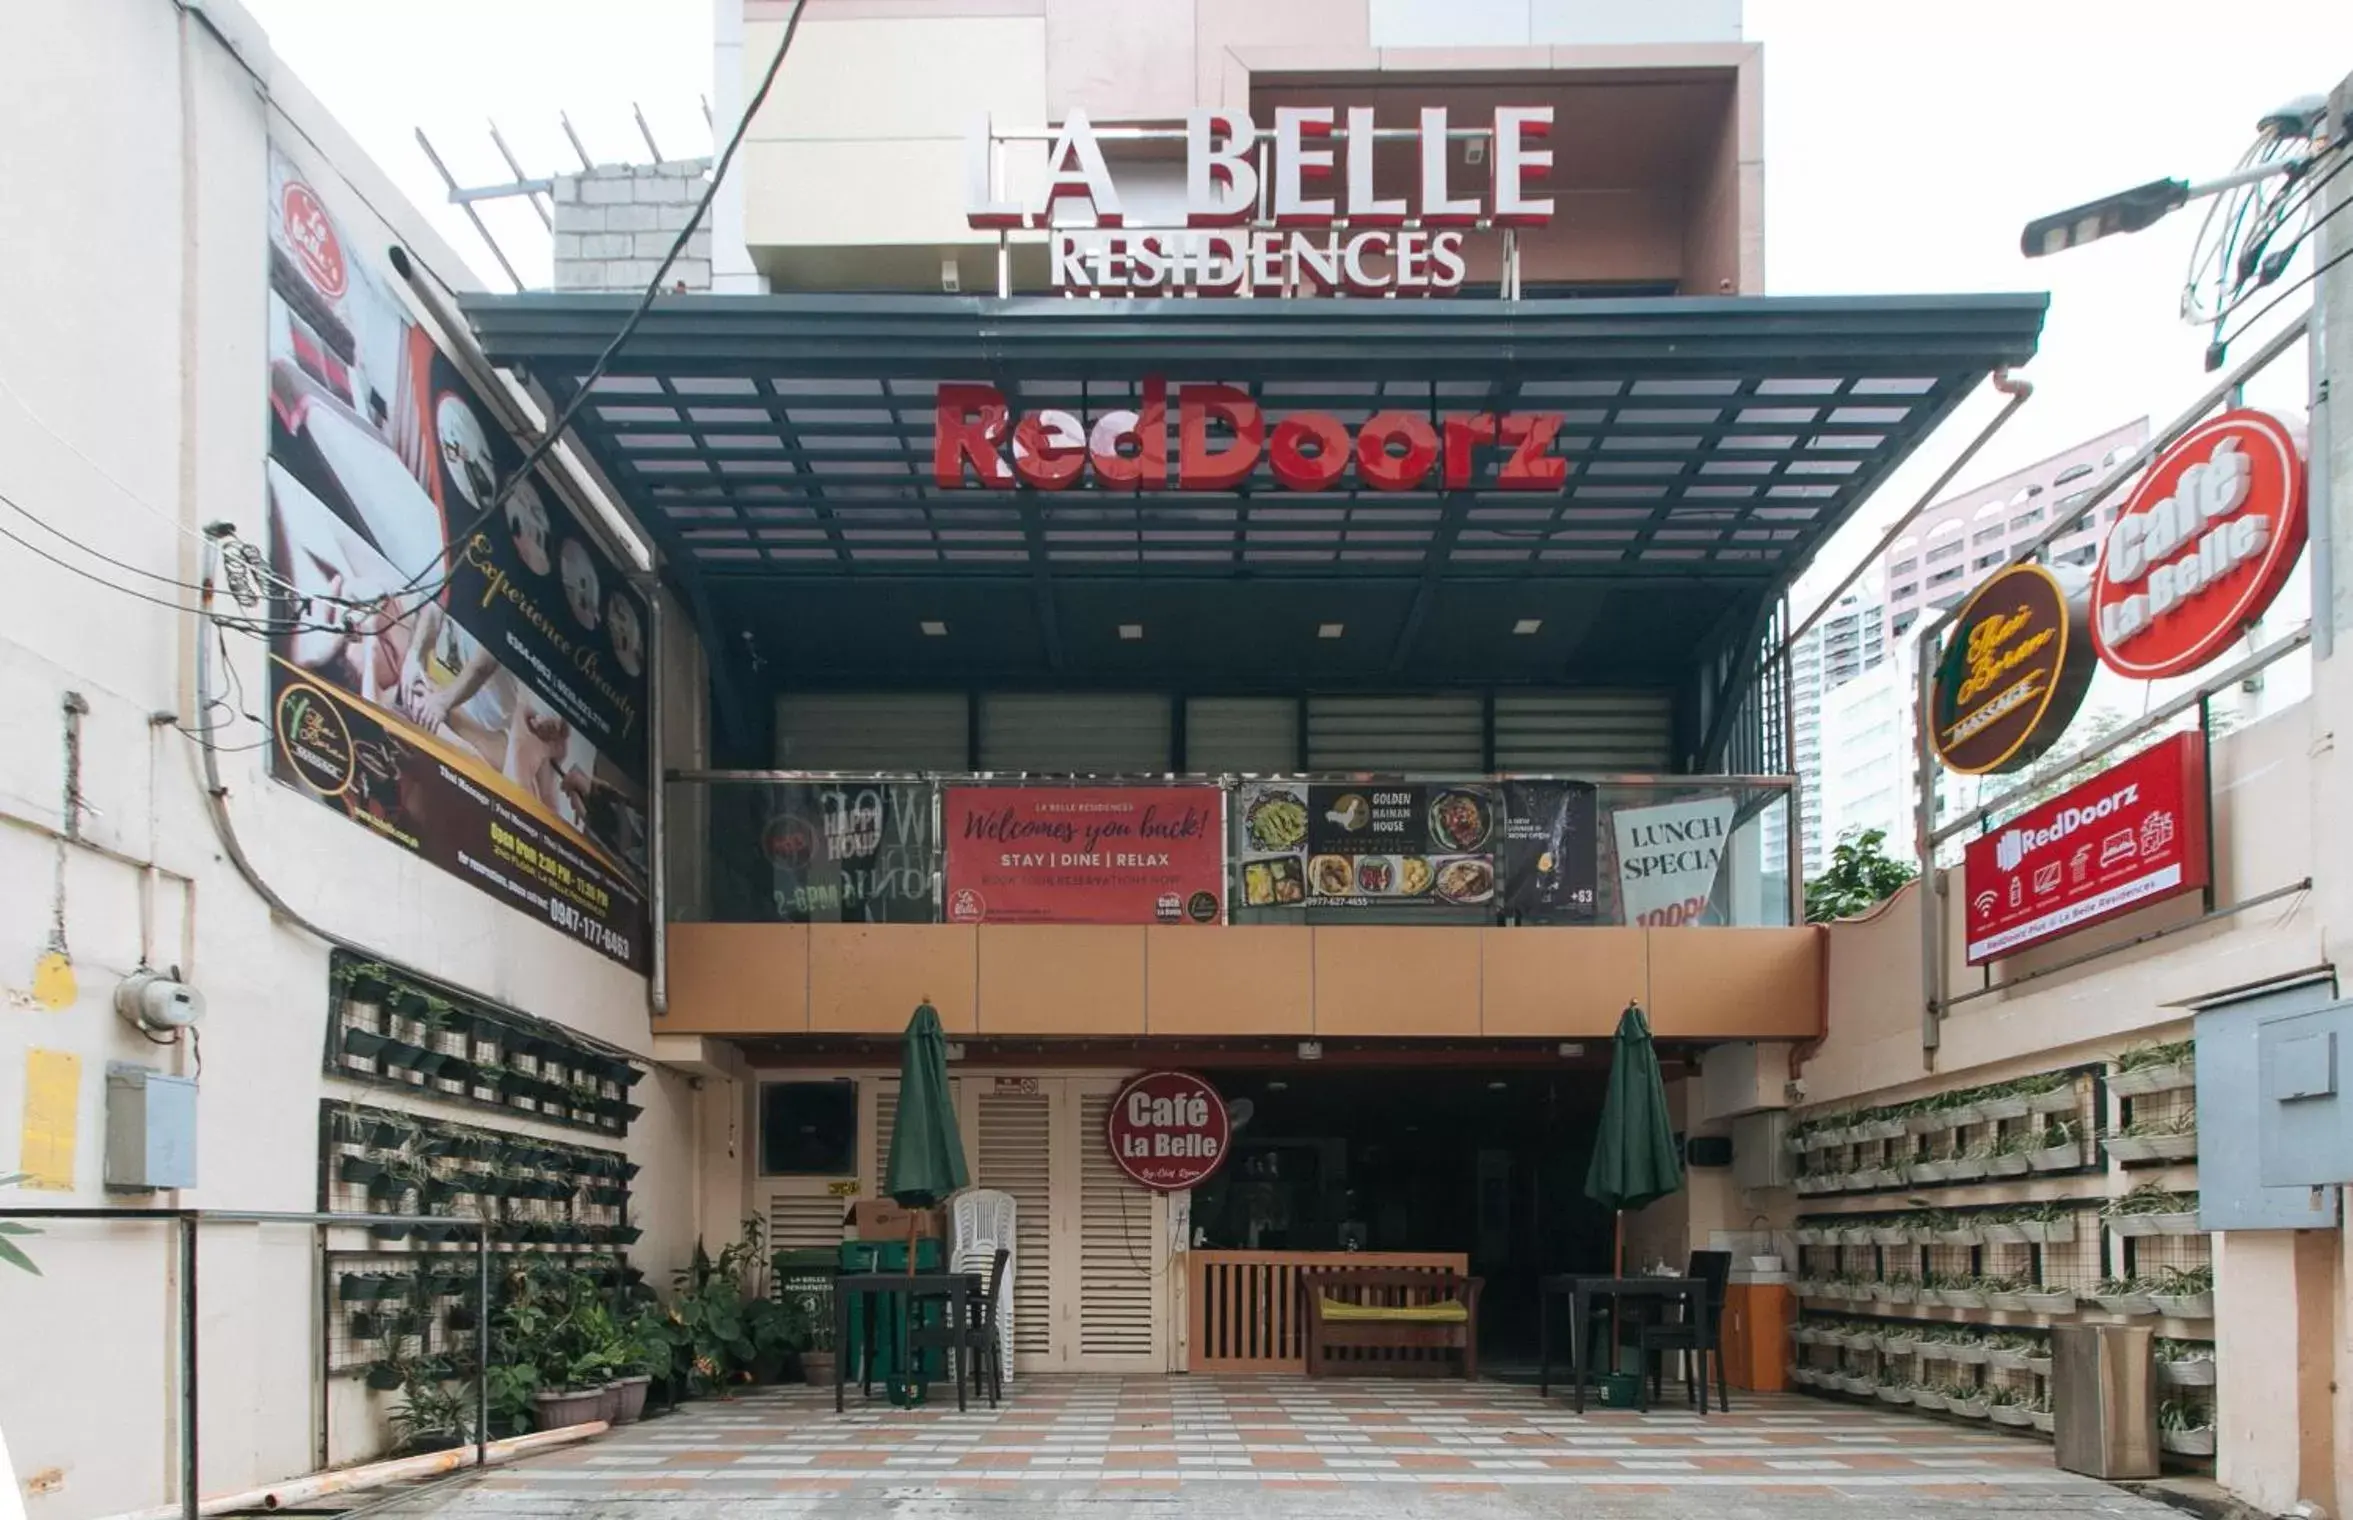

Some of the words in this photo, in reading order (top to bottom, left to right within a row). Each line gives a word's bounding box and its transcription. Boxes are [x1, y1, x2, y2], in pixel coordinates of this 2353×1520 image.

[968, 106, 1124, 228] LA
[1186, 106, 1554, 228] BELLE
[1050, 229, 1466, 296] RESIDENCES
[933, 372, 1568, 490] RedDoorz
[2108, 435, 2251, 584] Café
[2102, 595, 2152, 648] La
[2147, 513, 2272, 618] Belle
[1372, 793, 1412, 805] GOLDEN
[2021, 782, 2139, 855] RedDoorz
[964, 808, 1078, 843] Welcomes
[1083, 822, 1130, 852] you
[1140, 805, 1209, 840] back!
[1372, 821, 1405, 833] HOUSE
[1631, 815, 1724, 849] LUNCH
[1001, 853, 1050, 867] STAY
[1061, 853, 1101, 867] DINE
[1116, 853, 1169, 867] RELAX
[1623, 847, 1722, 881] SPECIA
[1128, 1090, 1209, 1127] Café
[1122, 1132, 1149, 1157] La
[1154, 1132, 1218, 1157] Belle
